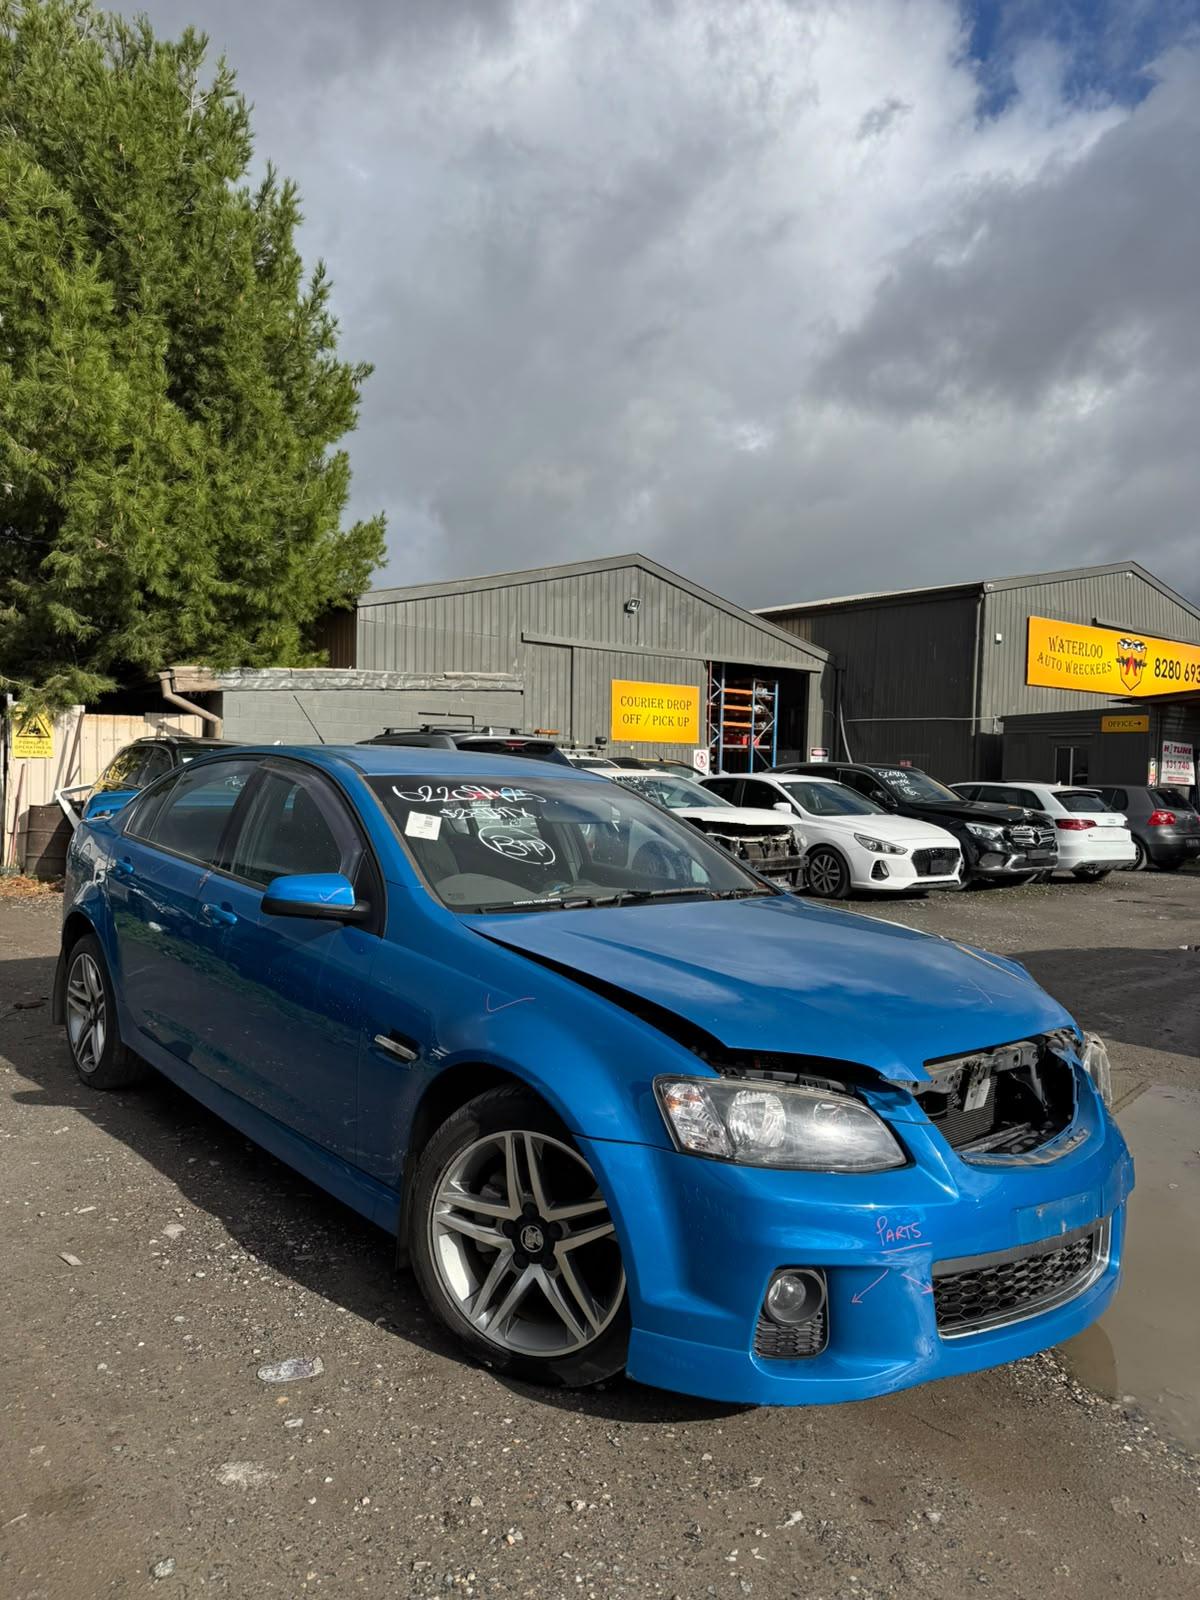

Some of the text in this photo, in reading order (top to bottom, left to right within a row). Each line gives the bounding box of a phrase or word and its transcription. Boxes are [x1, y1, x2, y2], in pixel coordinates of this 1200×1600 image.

[1048, 635, 1103, 659] WATERLOO
[1037, 651, 1112, 676] AUTO WRECKERS
[1154, 657, 1181, 681] 8280
[620, 695, 692, 711] COURIER DROP
[622, 713, 642, 725] OFF
[652, 714, 675, 727] PICK
[677, 716, 690, 728] UP
[1107, 720, 1134, 728] OFFICE
